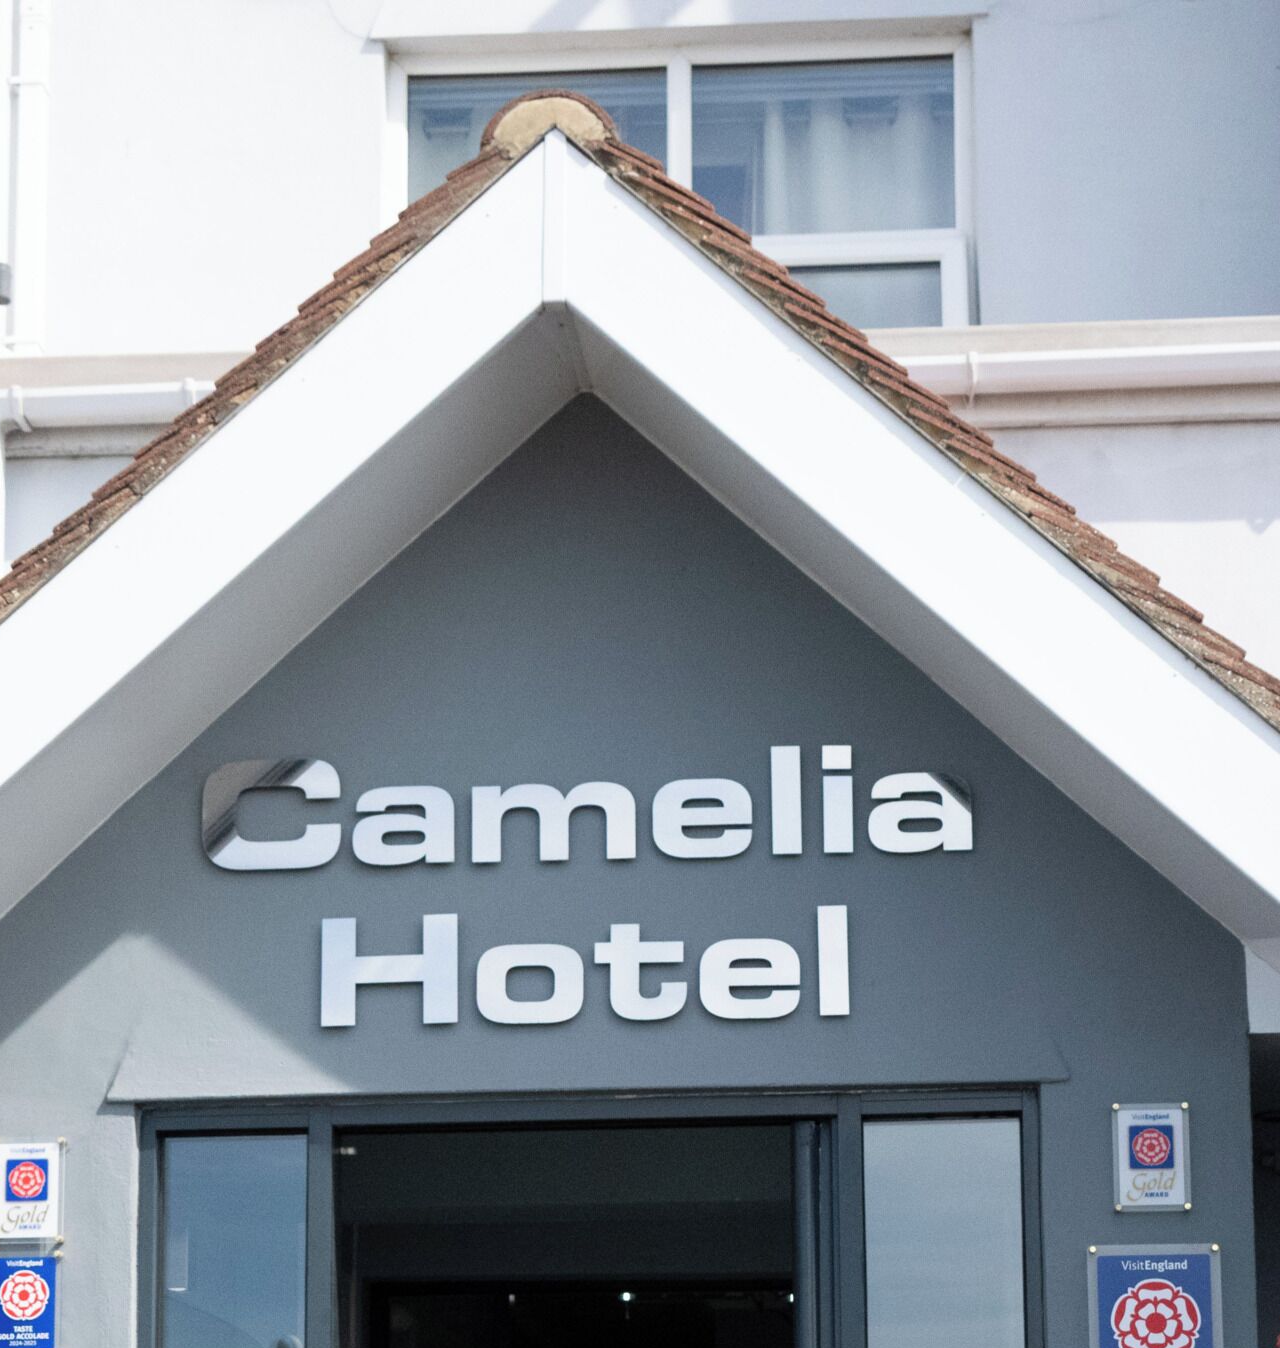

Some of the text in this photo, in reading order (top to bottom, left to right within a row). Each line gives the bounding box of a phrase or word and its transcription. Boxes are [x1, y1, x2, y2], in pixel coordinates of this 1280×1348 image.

[201, 744, 973, 870] Camelia
[320, 905, 850, 1027] Hotel
[1130, 1113, 1170, 1121] VisitEngland
[1127, 1170, 1177, 1201] Gold
[0, 1204, 50, 1233] Gold
[6, 1260, 44, 1268] VisitEngland
[1121, 1259, 1188, 1272] VisitEngland
[15, 1332, 50, 1340] ACCOLADE
